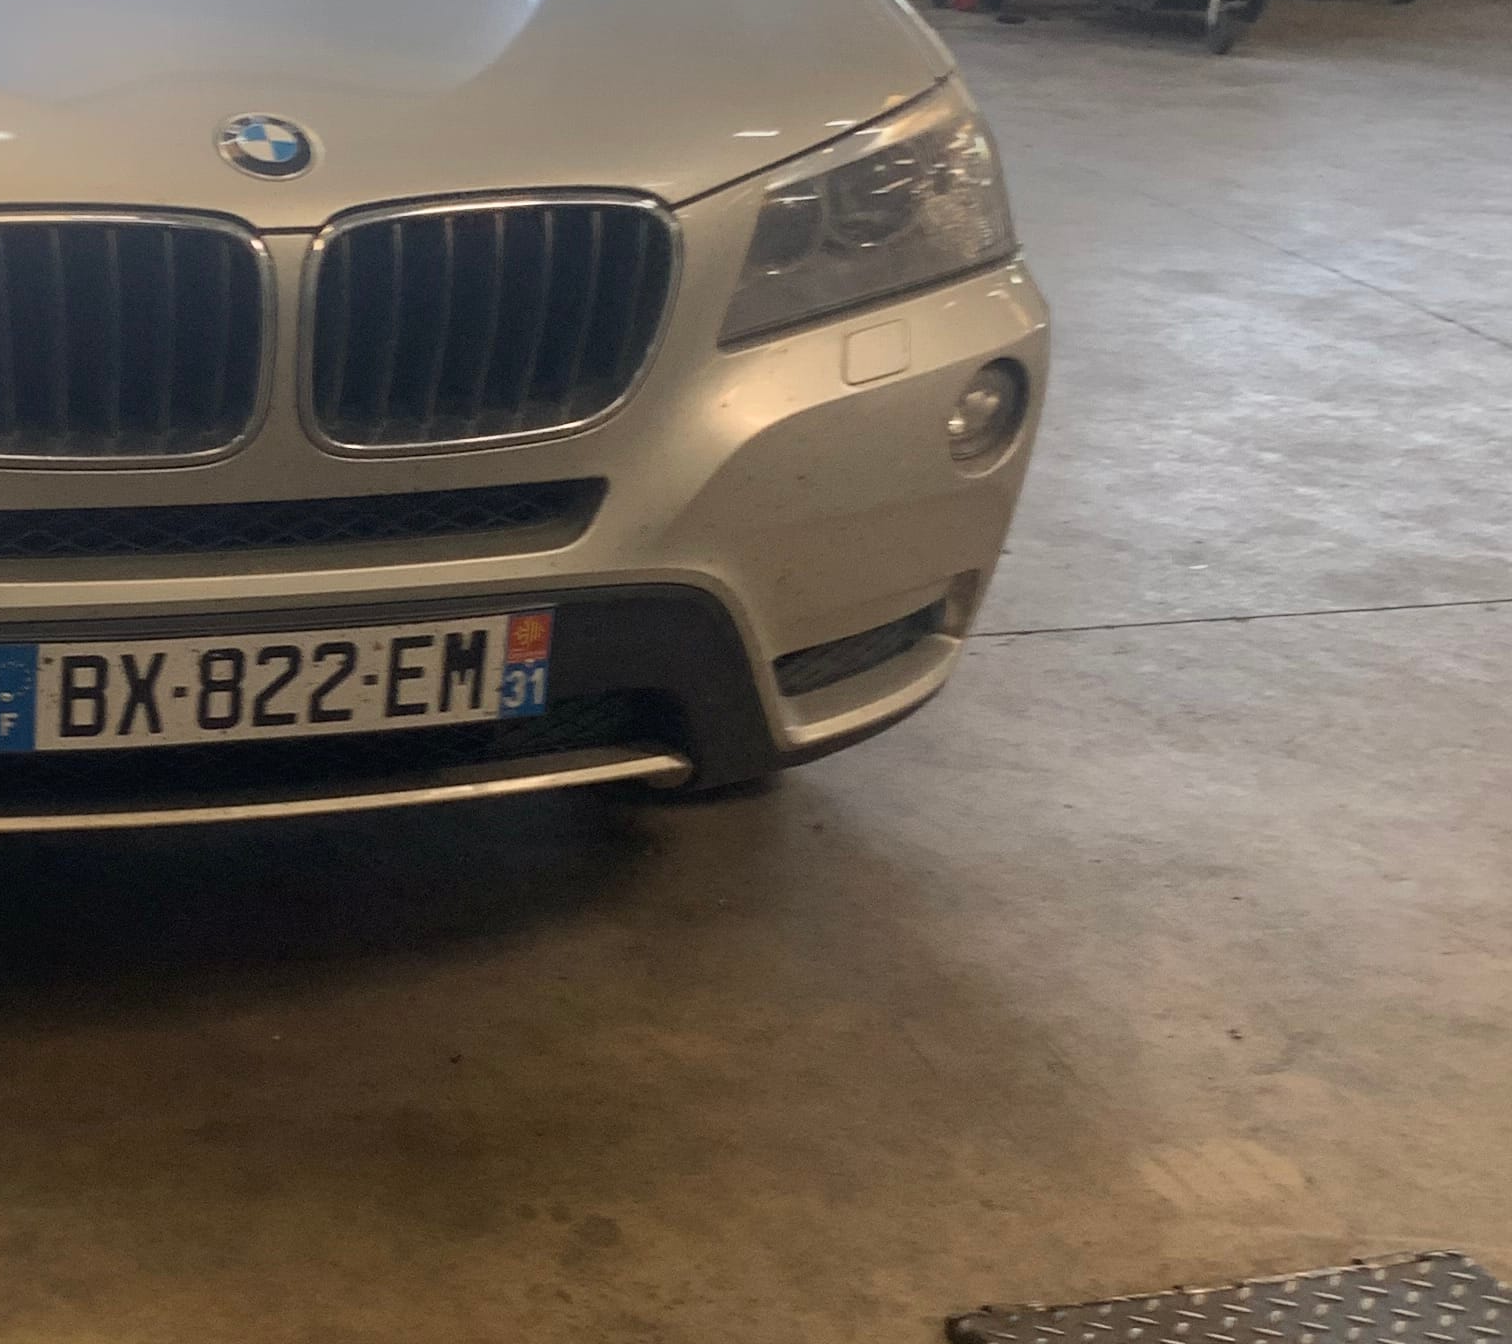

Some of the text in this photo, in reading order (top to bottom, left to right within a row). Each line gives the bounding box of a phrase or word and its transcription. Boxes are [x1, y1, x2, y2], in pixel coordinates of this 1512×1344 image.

[59, 629, 487, 738] BX-822-EM
[503, 667, 544, 708] 31
[0, 712, 18, 737] F
